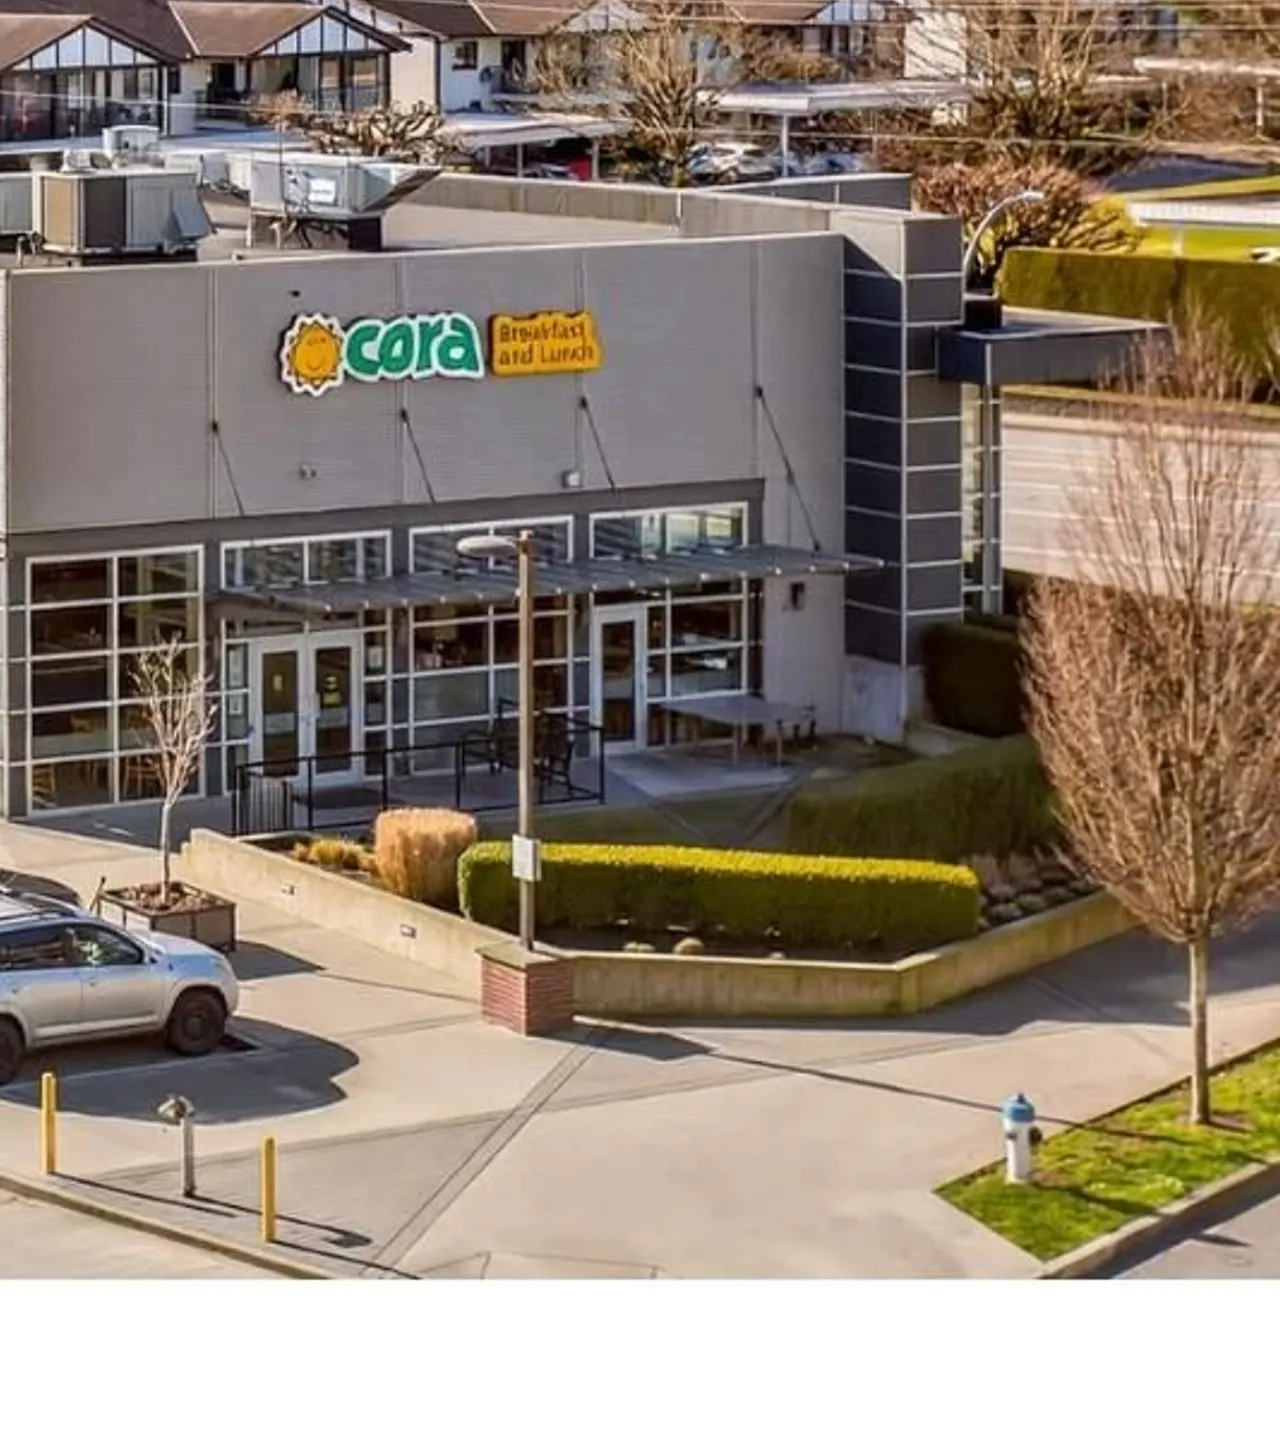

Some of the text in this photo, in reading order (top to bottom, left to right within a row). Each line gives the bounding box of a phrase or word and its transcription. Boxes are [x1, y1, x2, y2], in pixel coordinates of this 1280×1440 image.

[500, 321, 585, 343] Breakfast
[347, 317, 479, 375] cora
[500, 344, 594, 366] and Lunch
